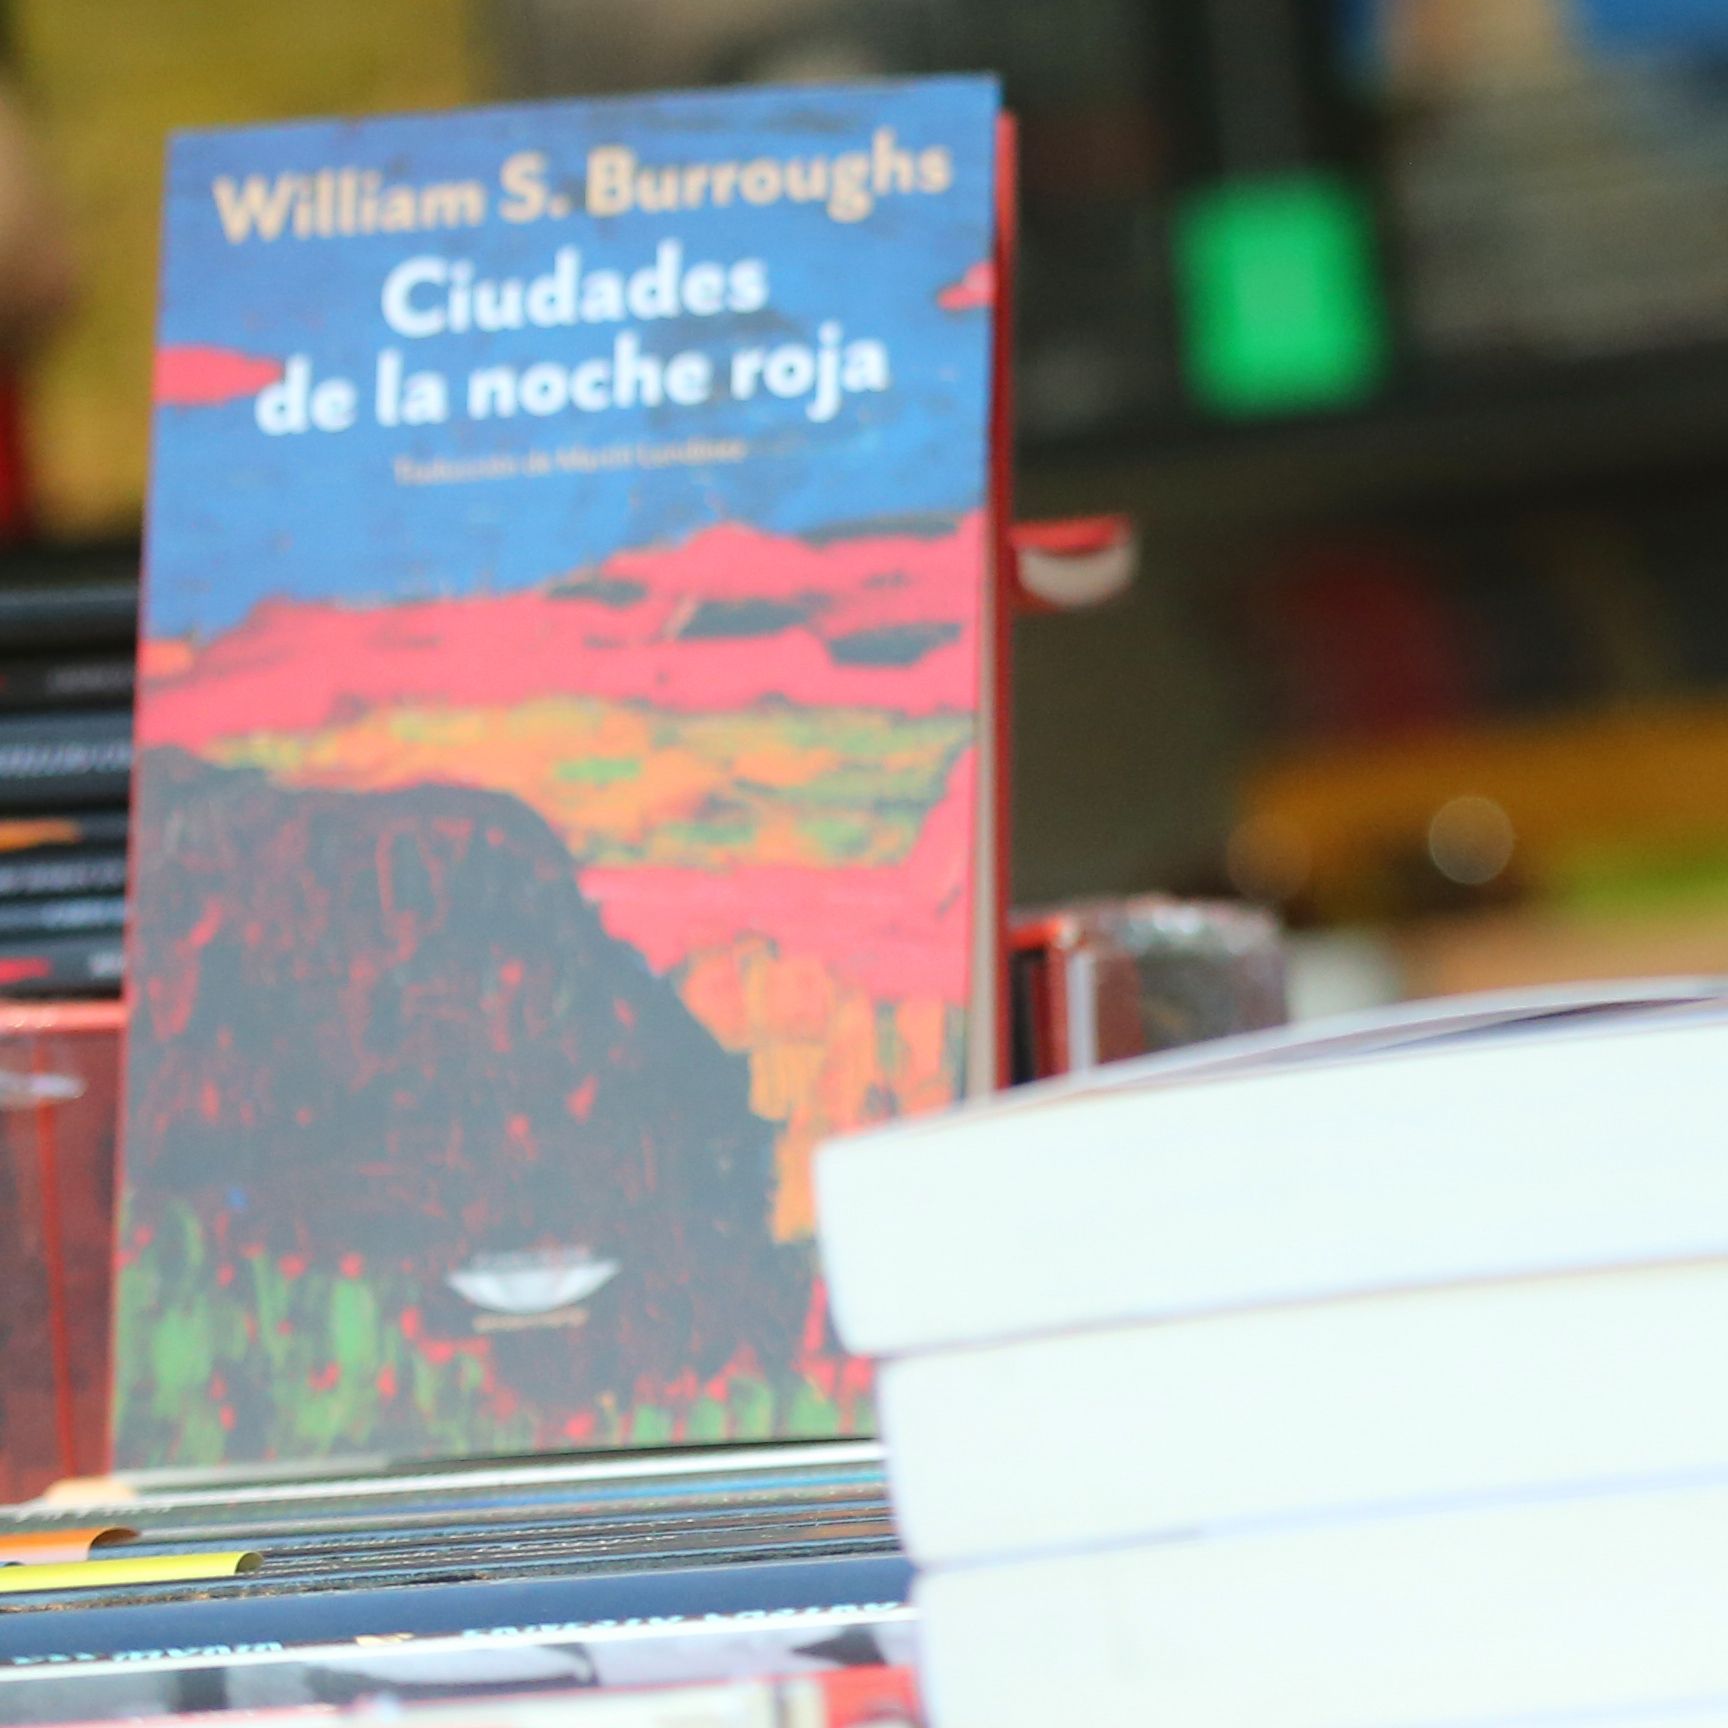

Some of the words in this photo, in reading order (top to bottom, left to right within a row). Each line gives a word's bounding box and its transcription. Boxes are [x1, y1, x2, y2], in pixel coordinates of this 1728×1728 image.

[214, 166, 482, 242] William
[499, 159, 568, 222] S.
[590, 129, 950, 220] Burroughs
[381, 241, 766, 337] Ciudades
[255, 354, 358, 437] de
[374, 345, 448, 427] la
[467, 329, 712, 418] noche
[728, 321, 890, 423] roja
